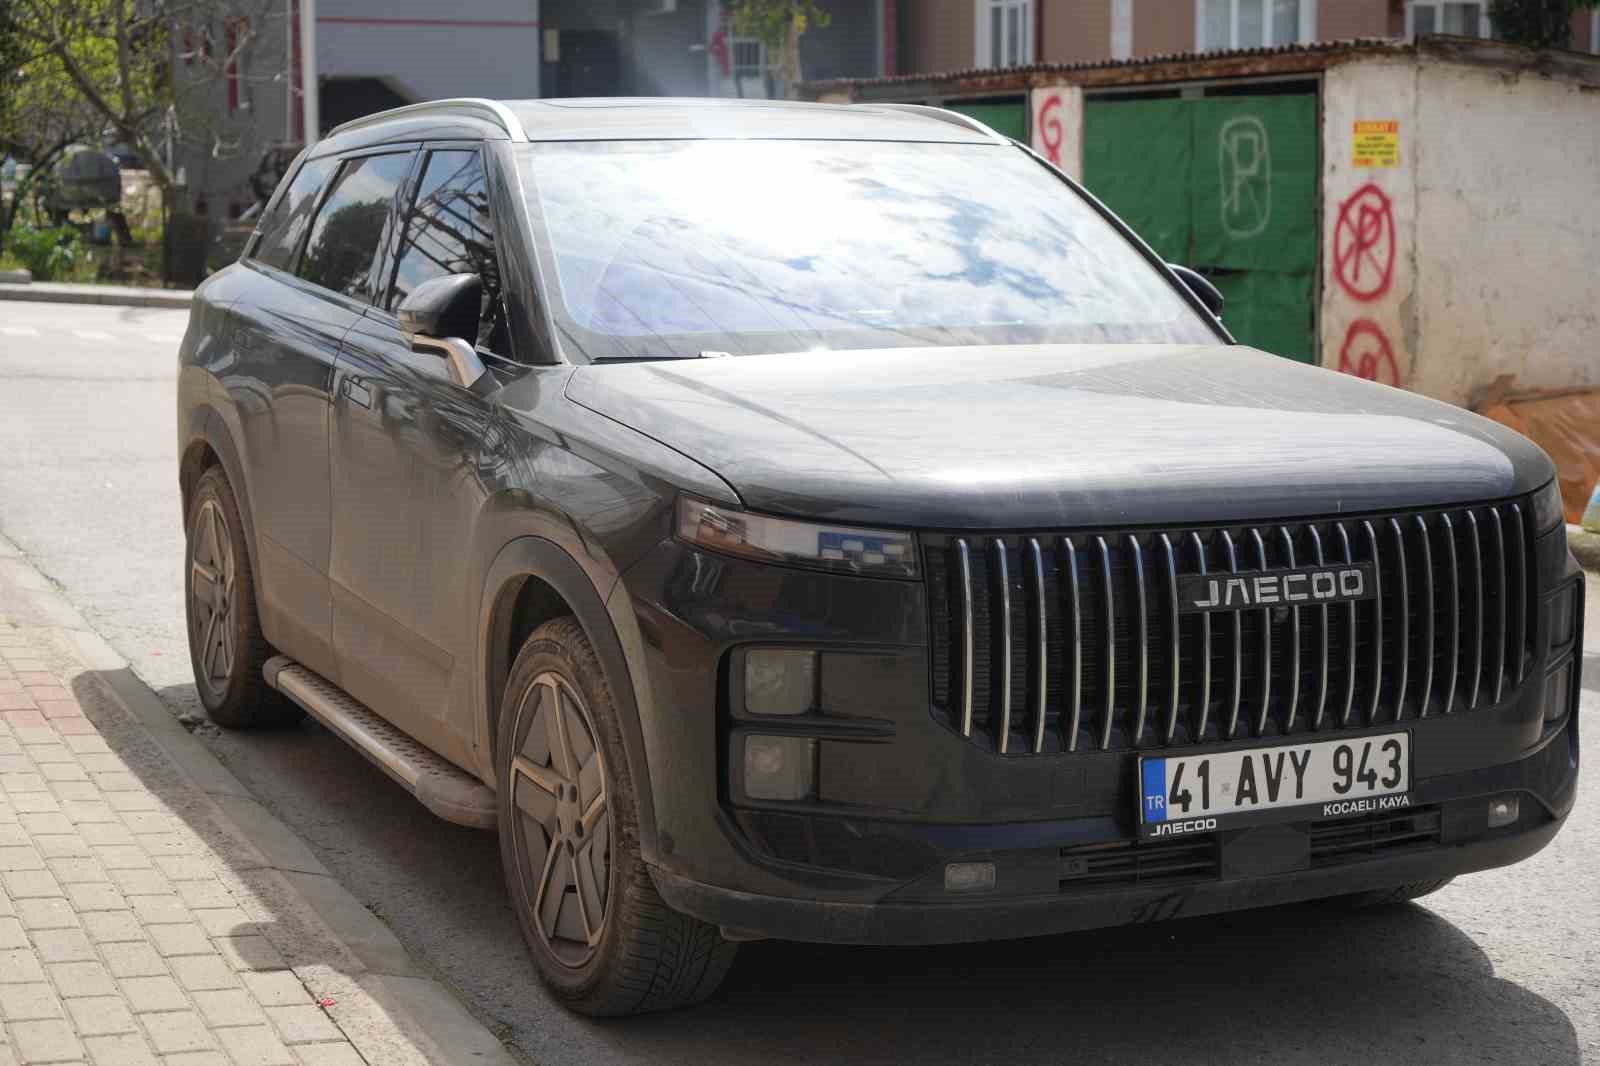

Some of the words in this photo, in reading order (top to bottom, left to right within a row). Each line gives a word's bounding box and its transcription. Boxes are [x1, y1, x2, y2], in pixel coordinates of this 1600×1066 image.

[1194, 569, 1364, 607] JAECOO
[1169, 760, 1210, 812] 41
[1235, 750, 1311, 806] AVY
[1332, 739, 1402, 794] 943
[1146, 795, 1164, 810] TR
[1379, 795, 1410, 809] KAYA
[1150, 818, 1217, 836] JAECOO
